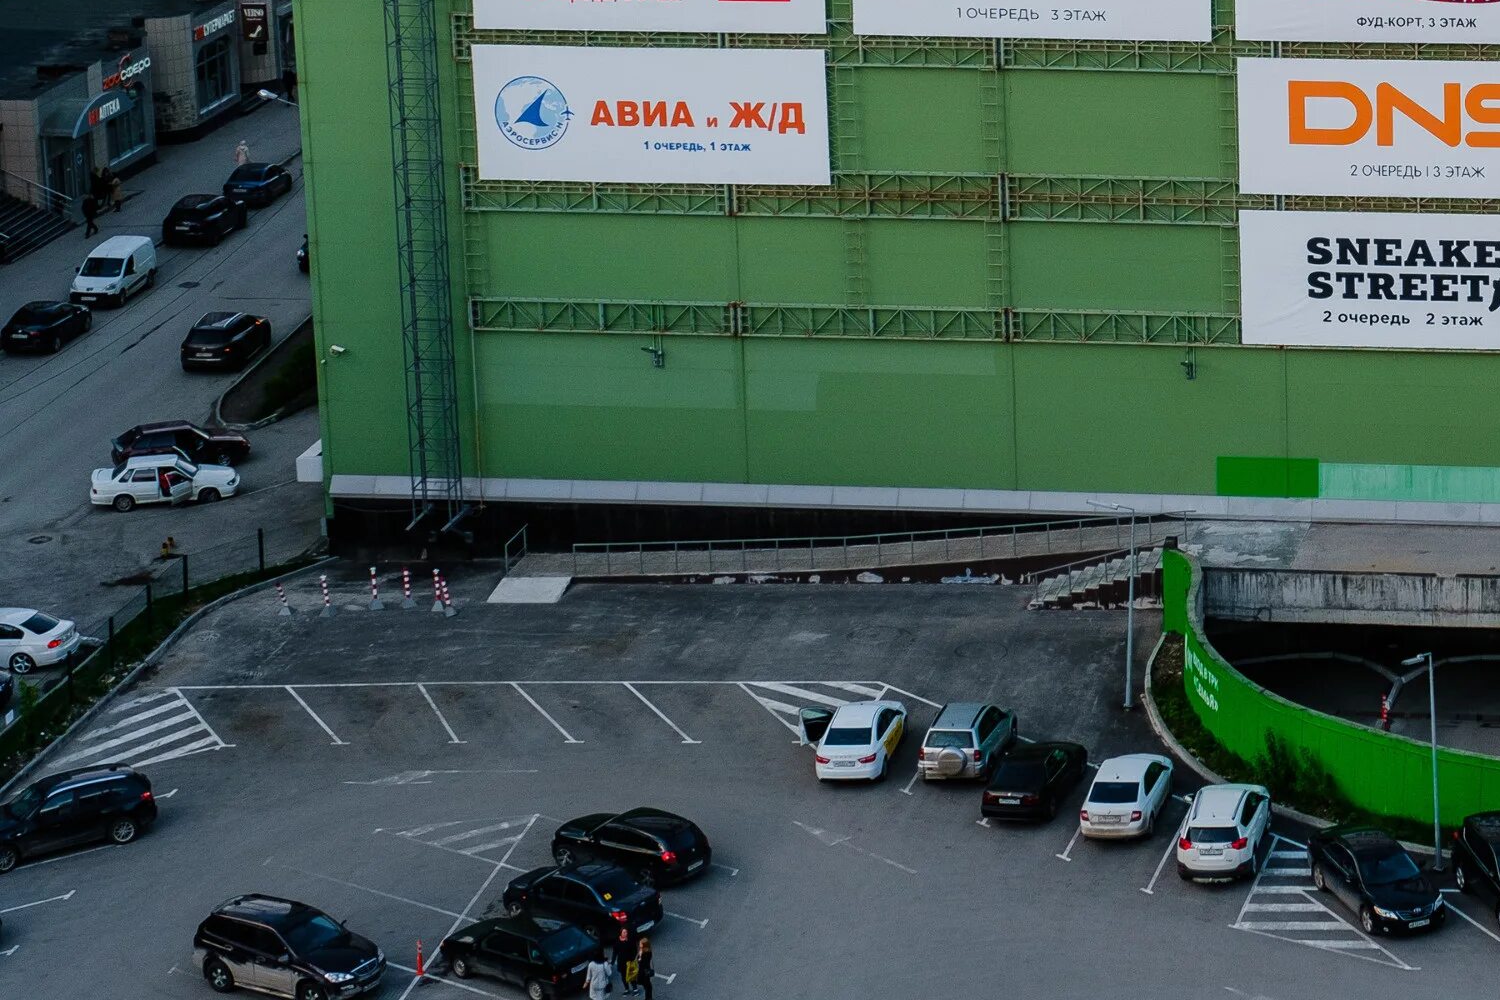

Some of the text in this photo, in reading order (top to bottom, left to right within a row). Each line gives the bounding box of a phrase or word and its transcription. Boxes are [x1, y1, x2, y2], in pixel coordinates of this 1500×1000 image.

[957, 7, 1107, 22] 1 ОЧЕРЕДЬ 3 ЭТАЖ
[1356, 16, 1477, 29] ФУД-КОРТ, 3 ЭТАЖ
[590, 100, 806, 134] АВИА и Ж/Д
[643, 140, 751, 152] 1 ОЧЕРЕДЬ, 1 ЭТАЖ
[1350, 164, 1486, 179] 2 ОЧЕРЕДЬ 3 ЭТАЖ
[1307, 271, 1490, 302] STREET
[1323, 310, 1483, 327] 2 очередь 2 этаж
